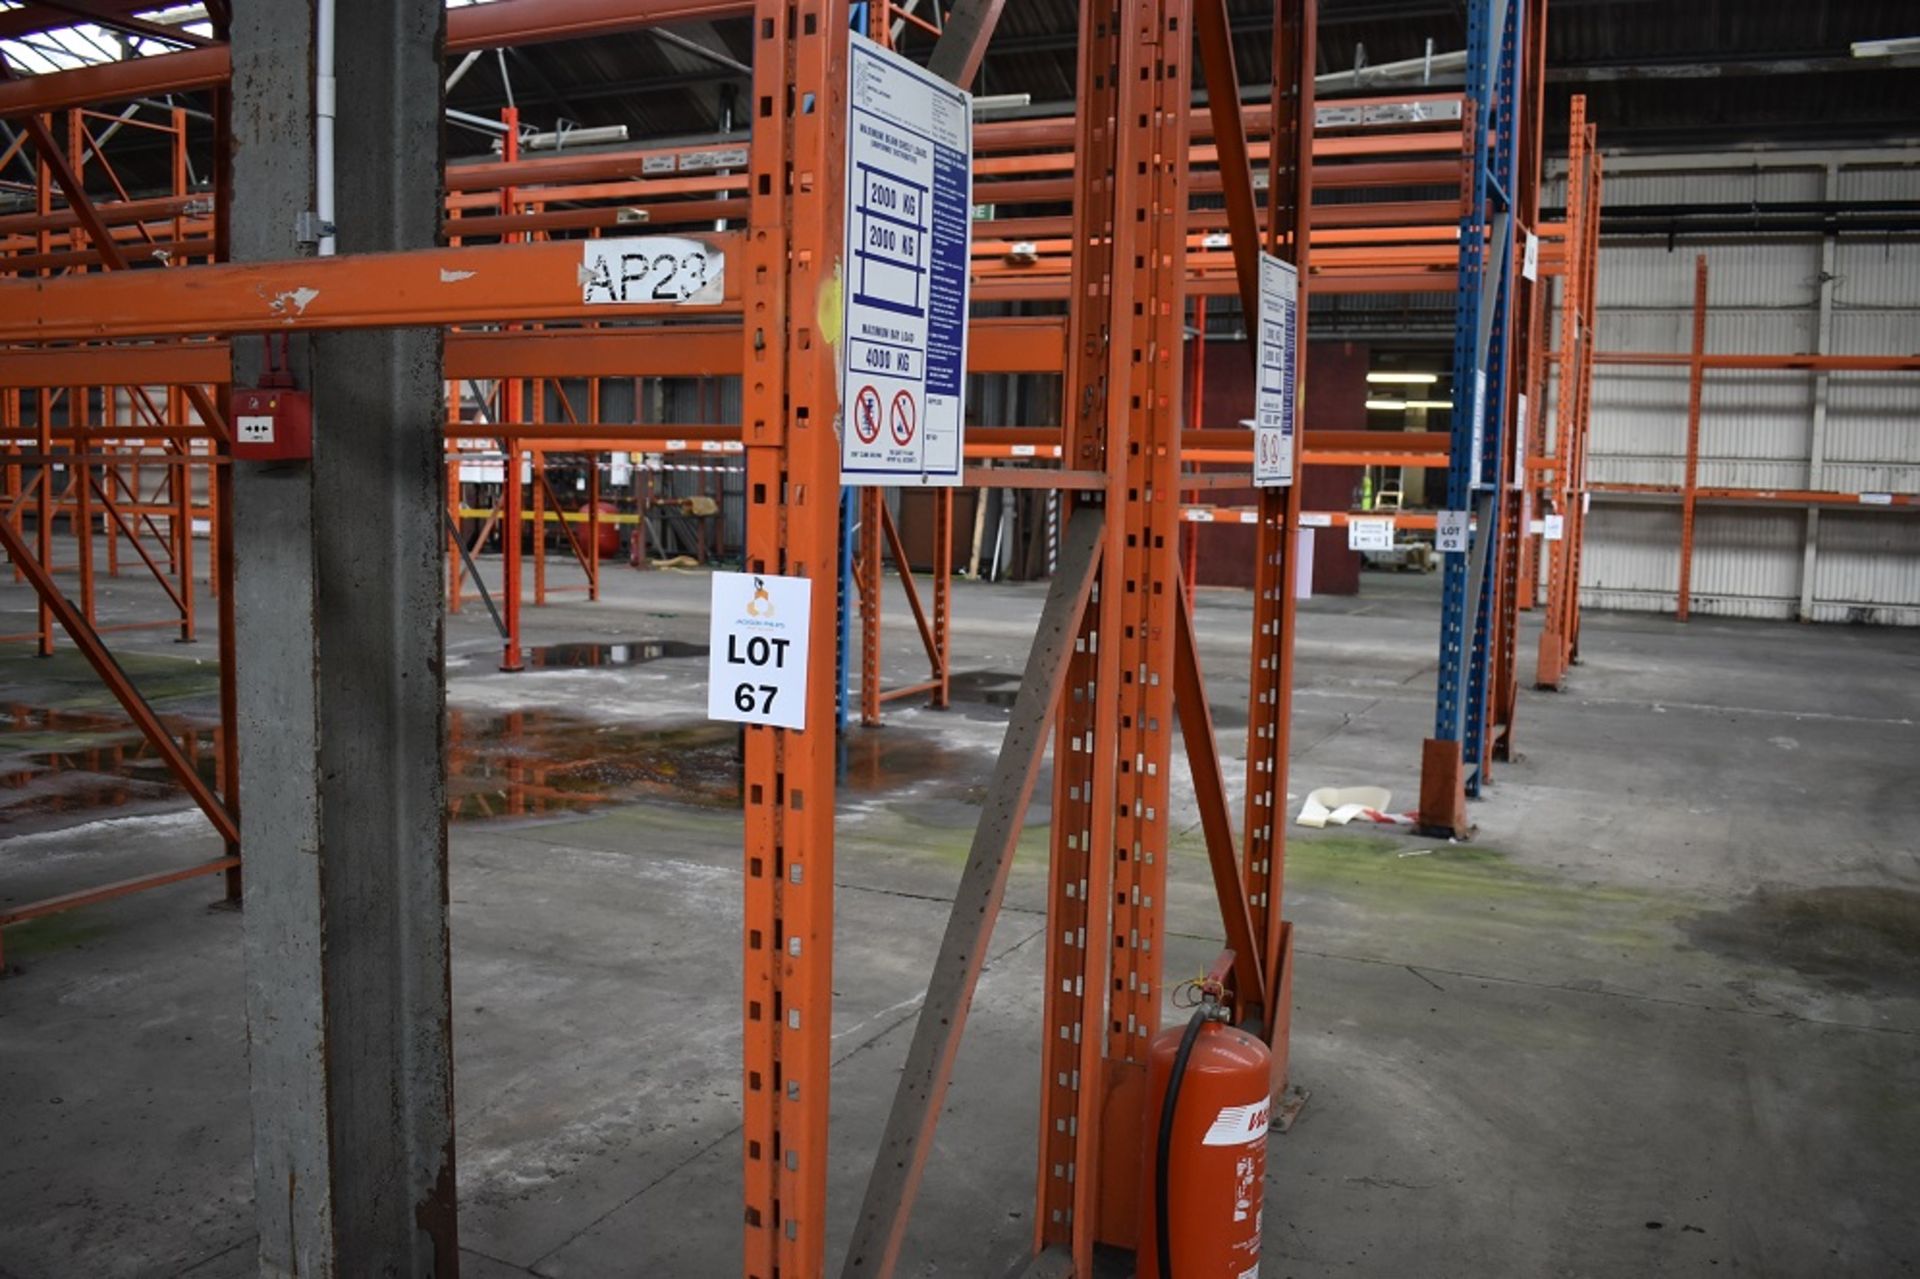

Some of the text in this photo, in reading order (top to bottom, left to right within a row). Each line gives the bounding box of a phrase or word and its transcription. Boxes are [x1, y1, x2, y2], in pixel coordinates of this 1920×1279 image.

[871, 182, 916, 216] 2000 KG
[870, 225, 914, 256] 2000 KG
[585, 252, 707, 302] AP23
[866, 348, 891, 370] 4000
[897, 353, 910, 372] KG
[1441, 527, 1461, 537] LOT
[727, 634, 790, 668] LOT
[734, 682, 778, 714] 67
